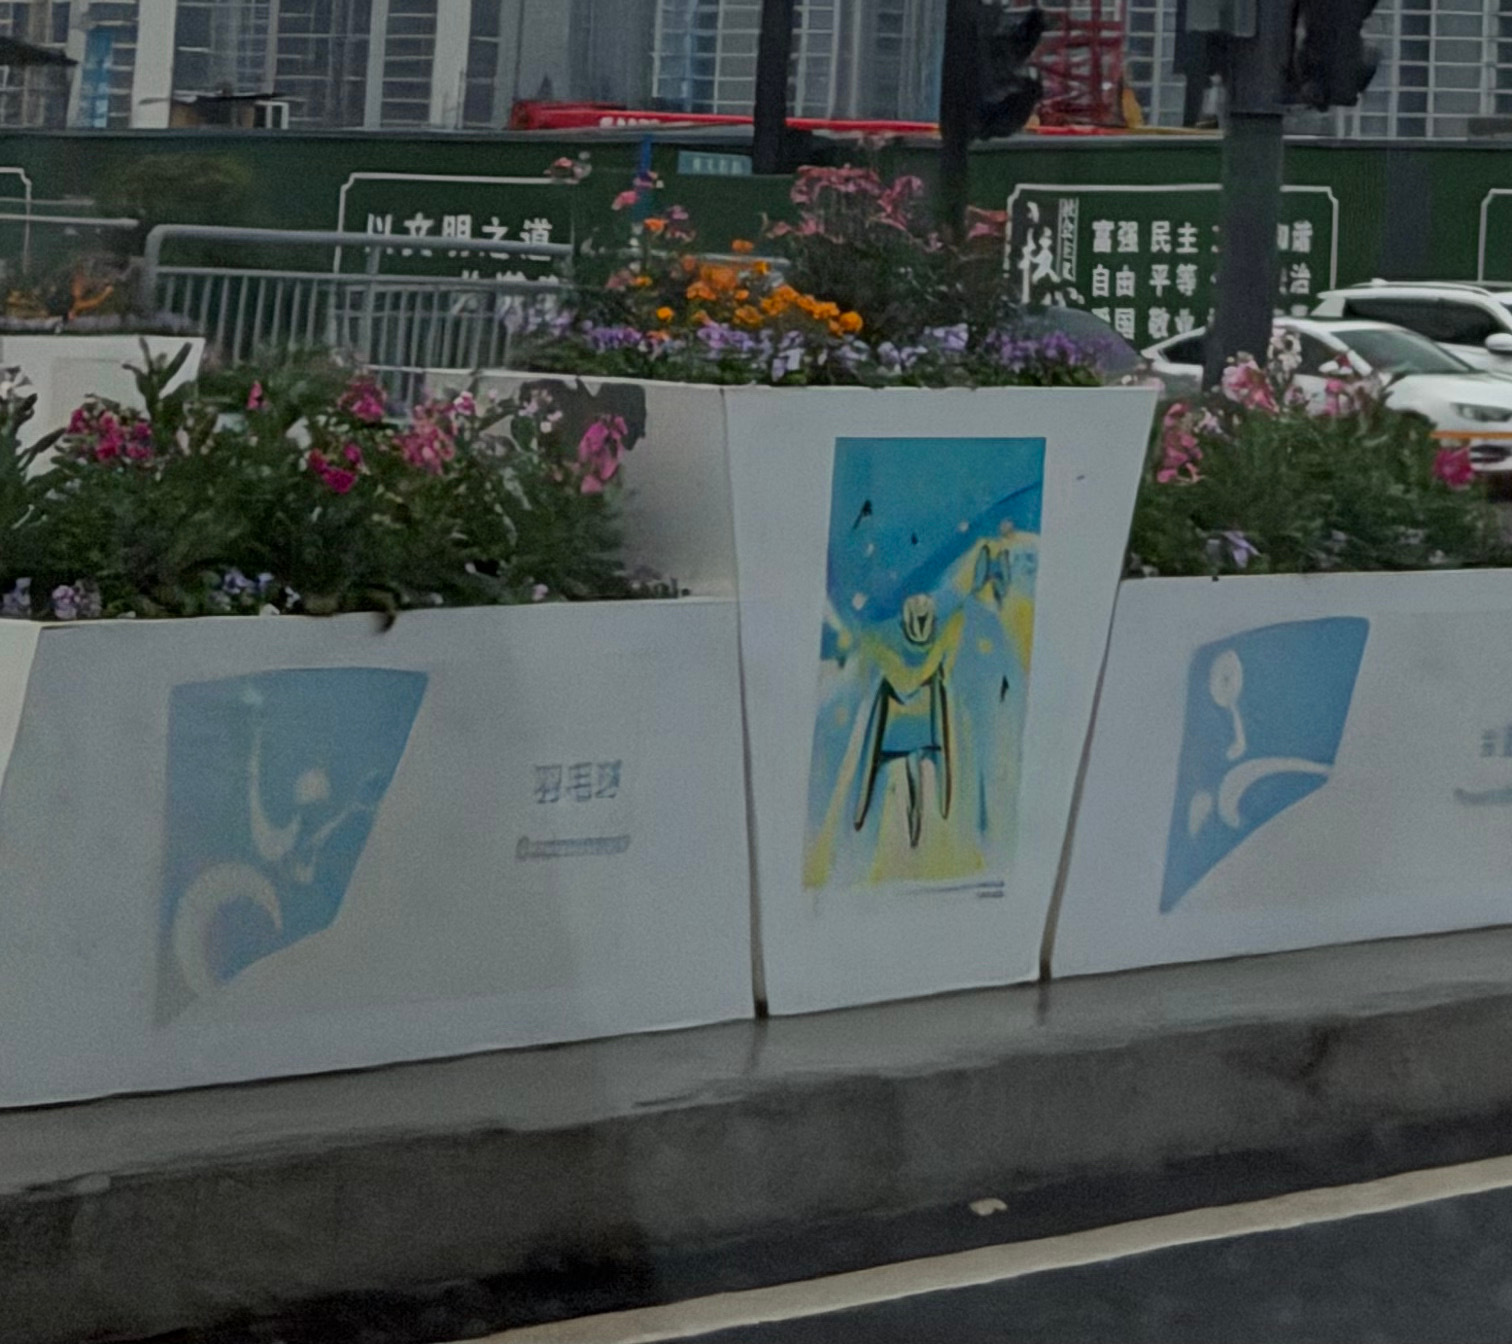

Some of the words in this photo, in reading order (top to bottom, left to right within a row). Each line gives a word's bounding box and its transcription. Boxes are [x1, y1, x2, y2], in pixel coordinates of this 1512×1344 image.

[1091, 219, 1139, 253] 富强
[1150, 220, 1199, 253] 民主
[1091, 263, 1136, 297] 自由
[1148, 263, 1198, 297] 平等
